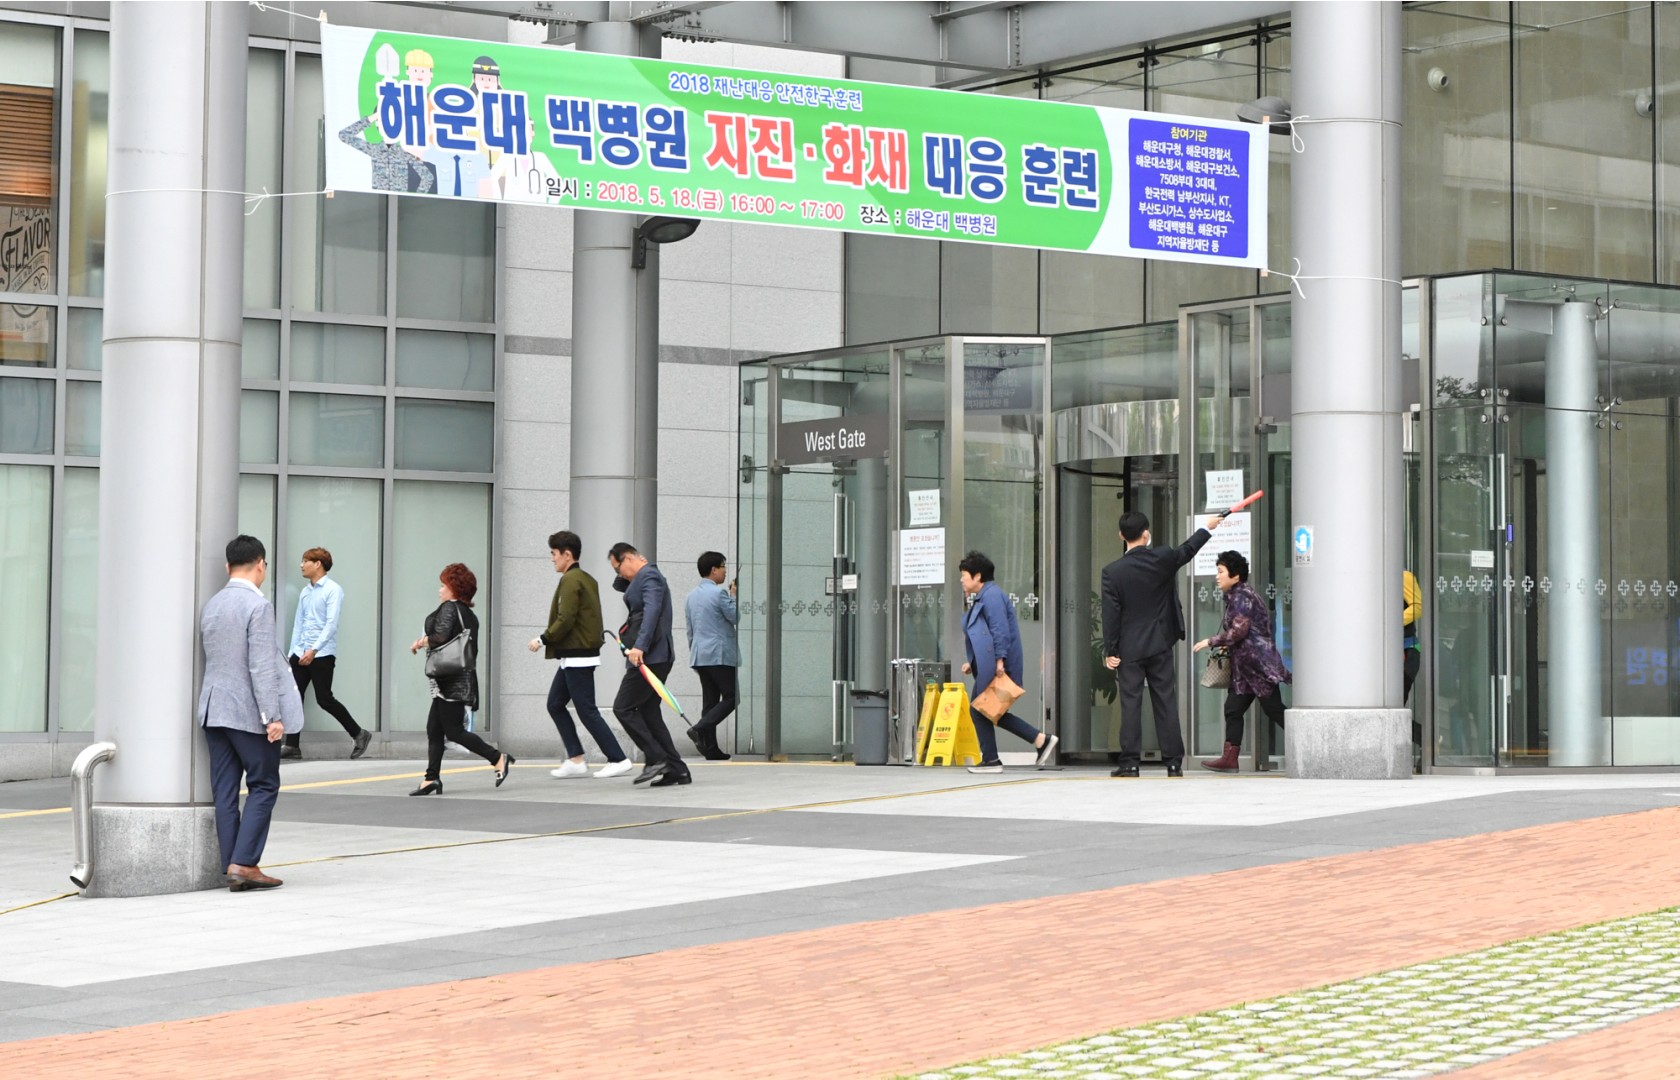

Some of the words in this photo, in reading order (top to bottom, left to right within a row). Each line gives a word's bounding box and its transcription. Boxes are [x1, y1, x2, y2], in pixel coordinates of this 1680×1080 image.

[669, 73, 710, 93] 2018
[714, 77, 773, 102] 재난대응
[378, 80, 527, 155] 해운대
[548, 98, 687, 170] 백병원
[925, 135, 1004, 200] 대응
[1024, 146, 1097, 208] 훈련
[1170, 127, 1208, 142] 참여기관
[1143, 140, 1184, 156] 해운대구청,
[1186, 145, 1233, 162] 해운대경찰서,
[1135, 155, 1184, 172] 해운대소방서,
[1186, 160, 1240, 178] 해운대구보건소,
[1160, 173, 1193, 188] 7508부대
[1195, 177, 1217, 191] 3대대,
[546, 178, 577, 198] 일시
[598, 182, 643, 203] 2018.
[650, 187, 665, 206] 5.
[672, 189, 724, 212] 18.(금)
[730, 195, 775, 214] 16:00
[800, 201, 844, 220] 17:00
[860, 205, 889, 224] 장소
[906, 209, 949, 231] 해운대
[954, 213, 996, 235] 백병원
[1145, 186, 1175, 201] 한국전력
[1177, 190, 1217, 206] 남부산지사,
[1219, 195, 1232, 208] KT,
[1138, 202, 1186, 218] 부산도시가스,
[1188, 207, 1235, 224] 상수도사업소,
[1148, 218, 1196, 235] 해운대백병원,
[1198, 221, 1228, 238] 해운대구
[1157, 235, 1209, 252] 지역자율방재단
[805, 431, 836, 452] West
[838, 428, 866, 449] Gate
